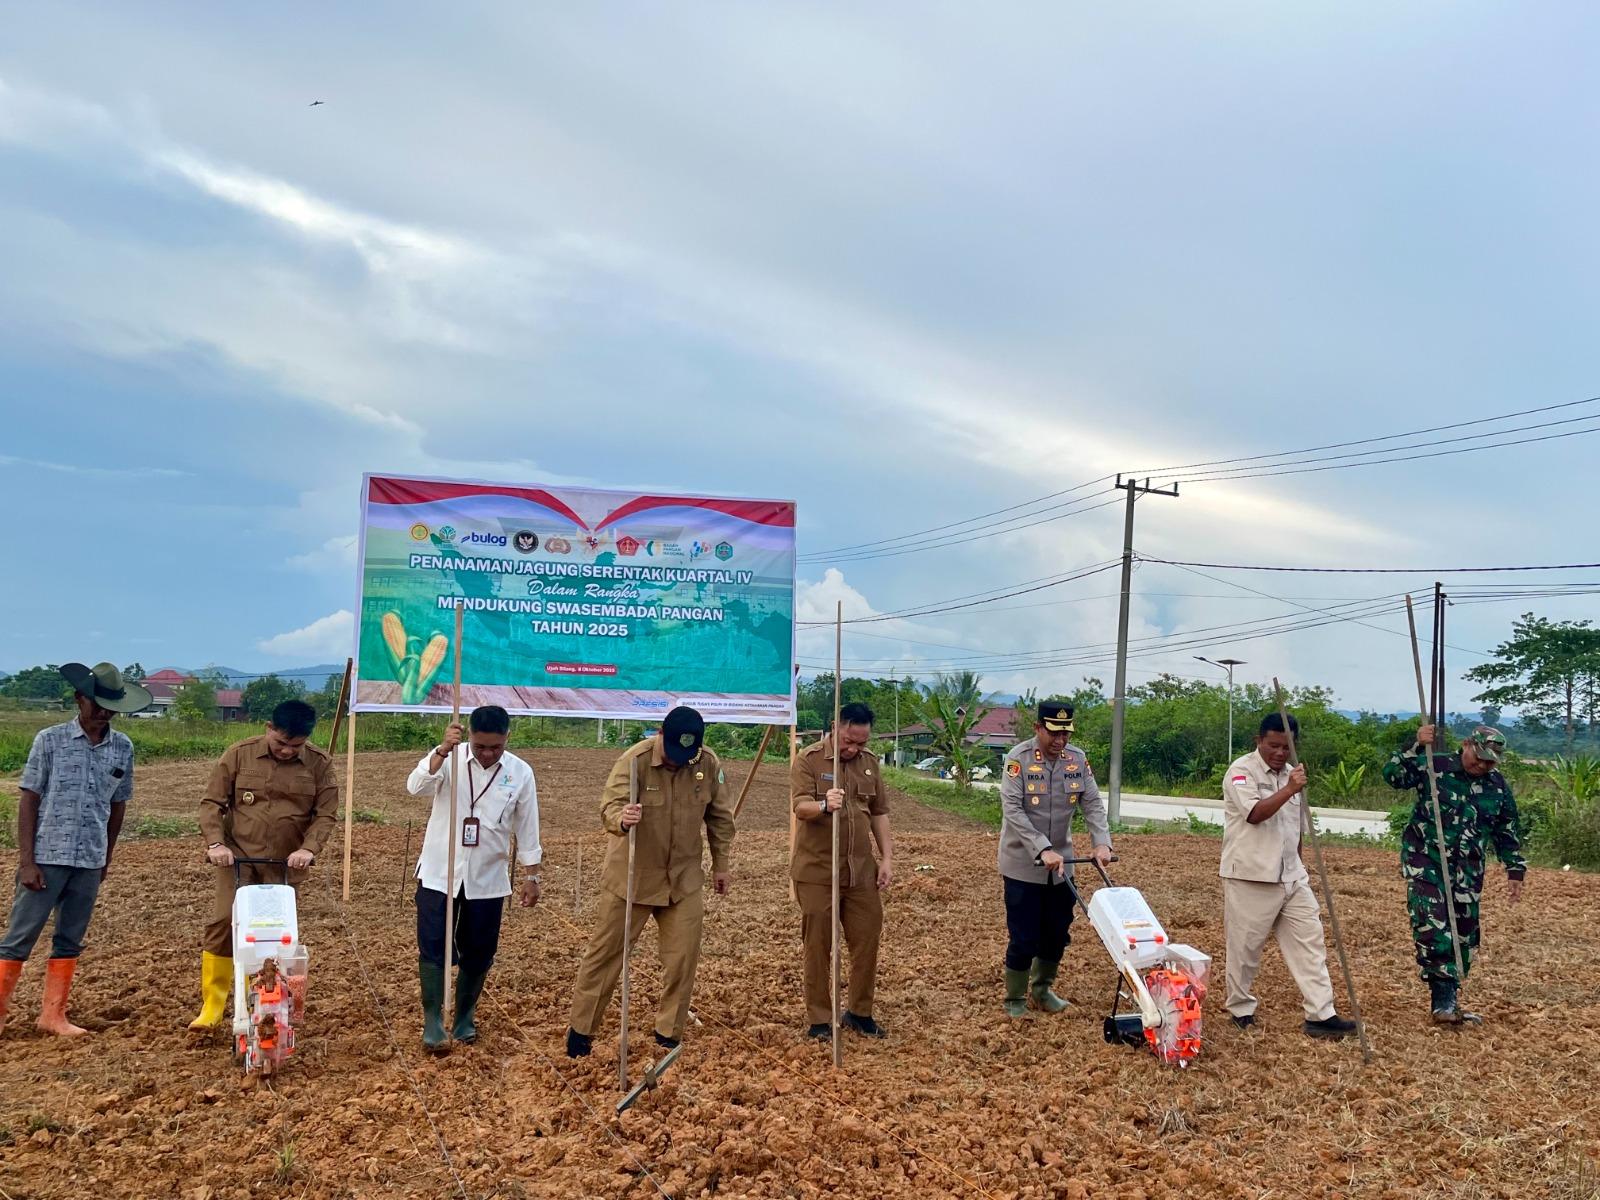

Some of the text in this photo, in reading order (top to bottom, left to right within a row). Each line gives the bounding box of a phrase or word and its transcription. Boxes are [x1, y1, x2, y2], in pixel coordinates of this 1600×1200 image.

[471, 531, 507, 547] bulog
[410, 554, 752, 584] PENANAMAN JAGUNG SERENTAK KUARTAL IV
[528, 580, 640, 601] Dalam Rangka
[438, 595, 723, 622] MENDUKUNG SWASEMBADA PANGAN
[532, 620, 628, 637] TAHUN 2025
[1064, 772, 1082, 780] POLRI
